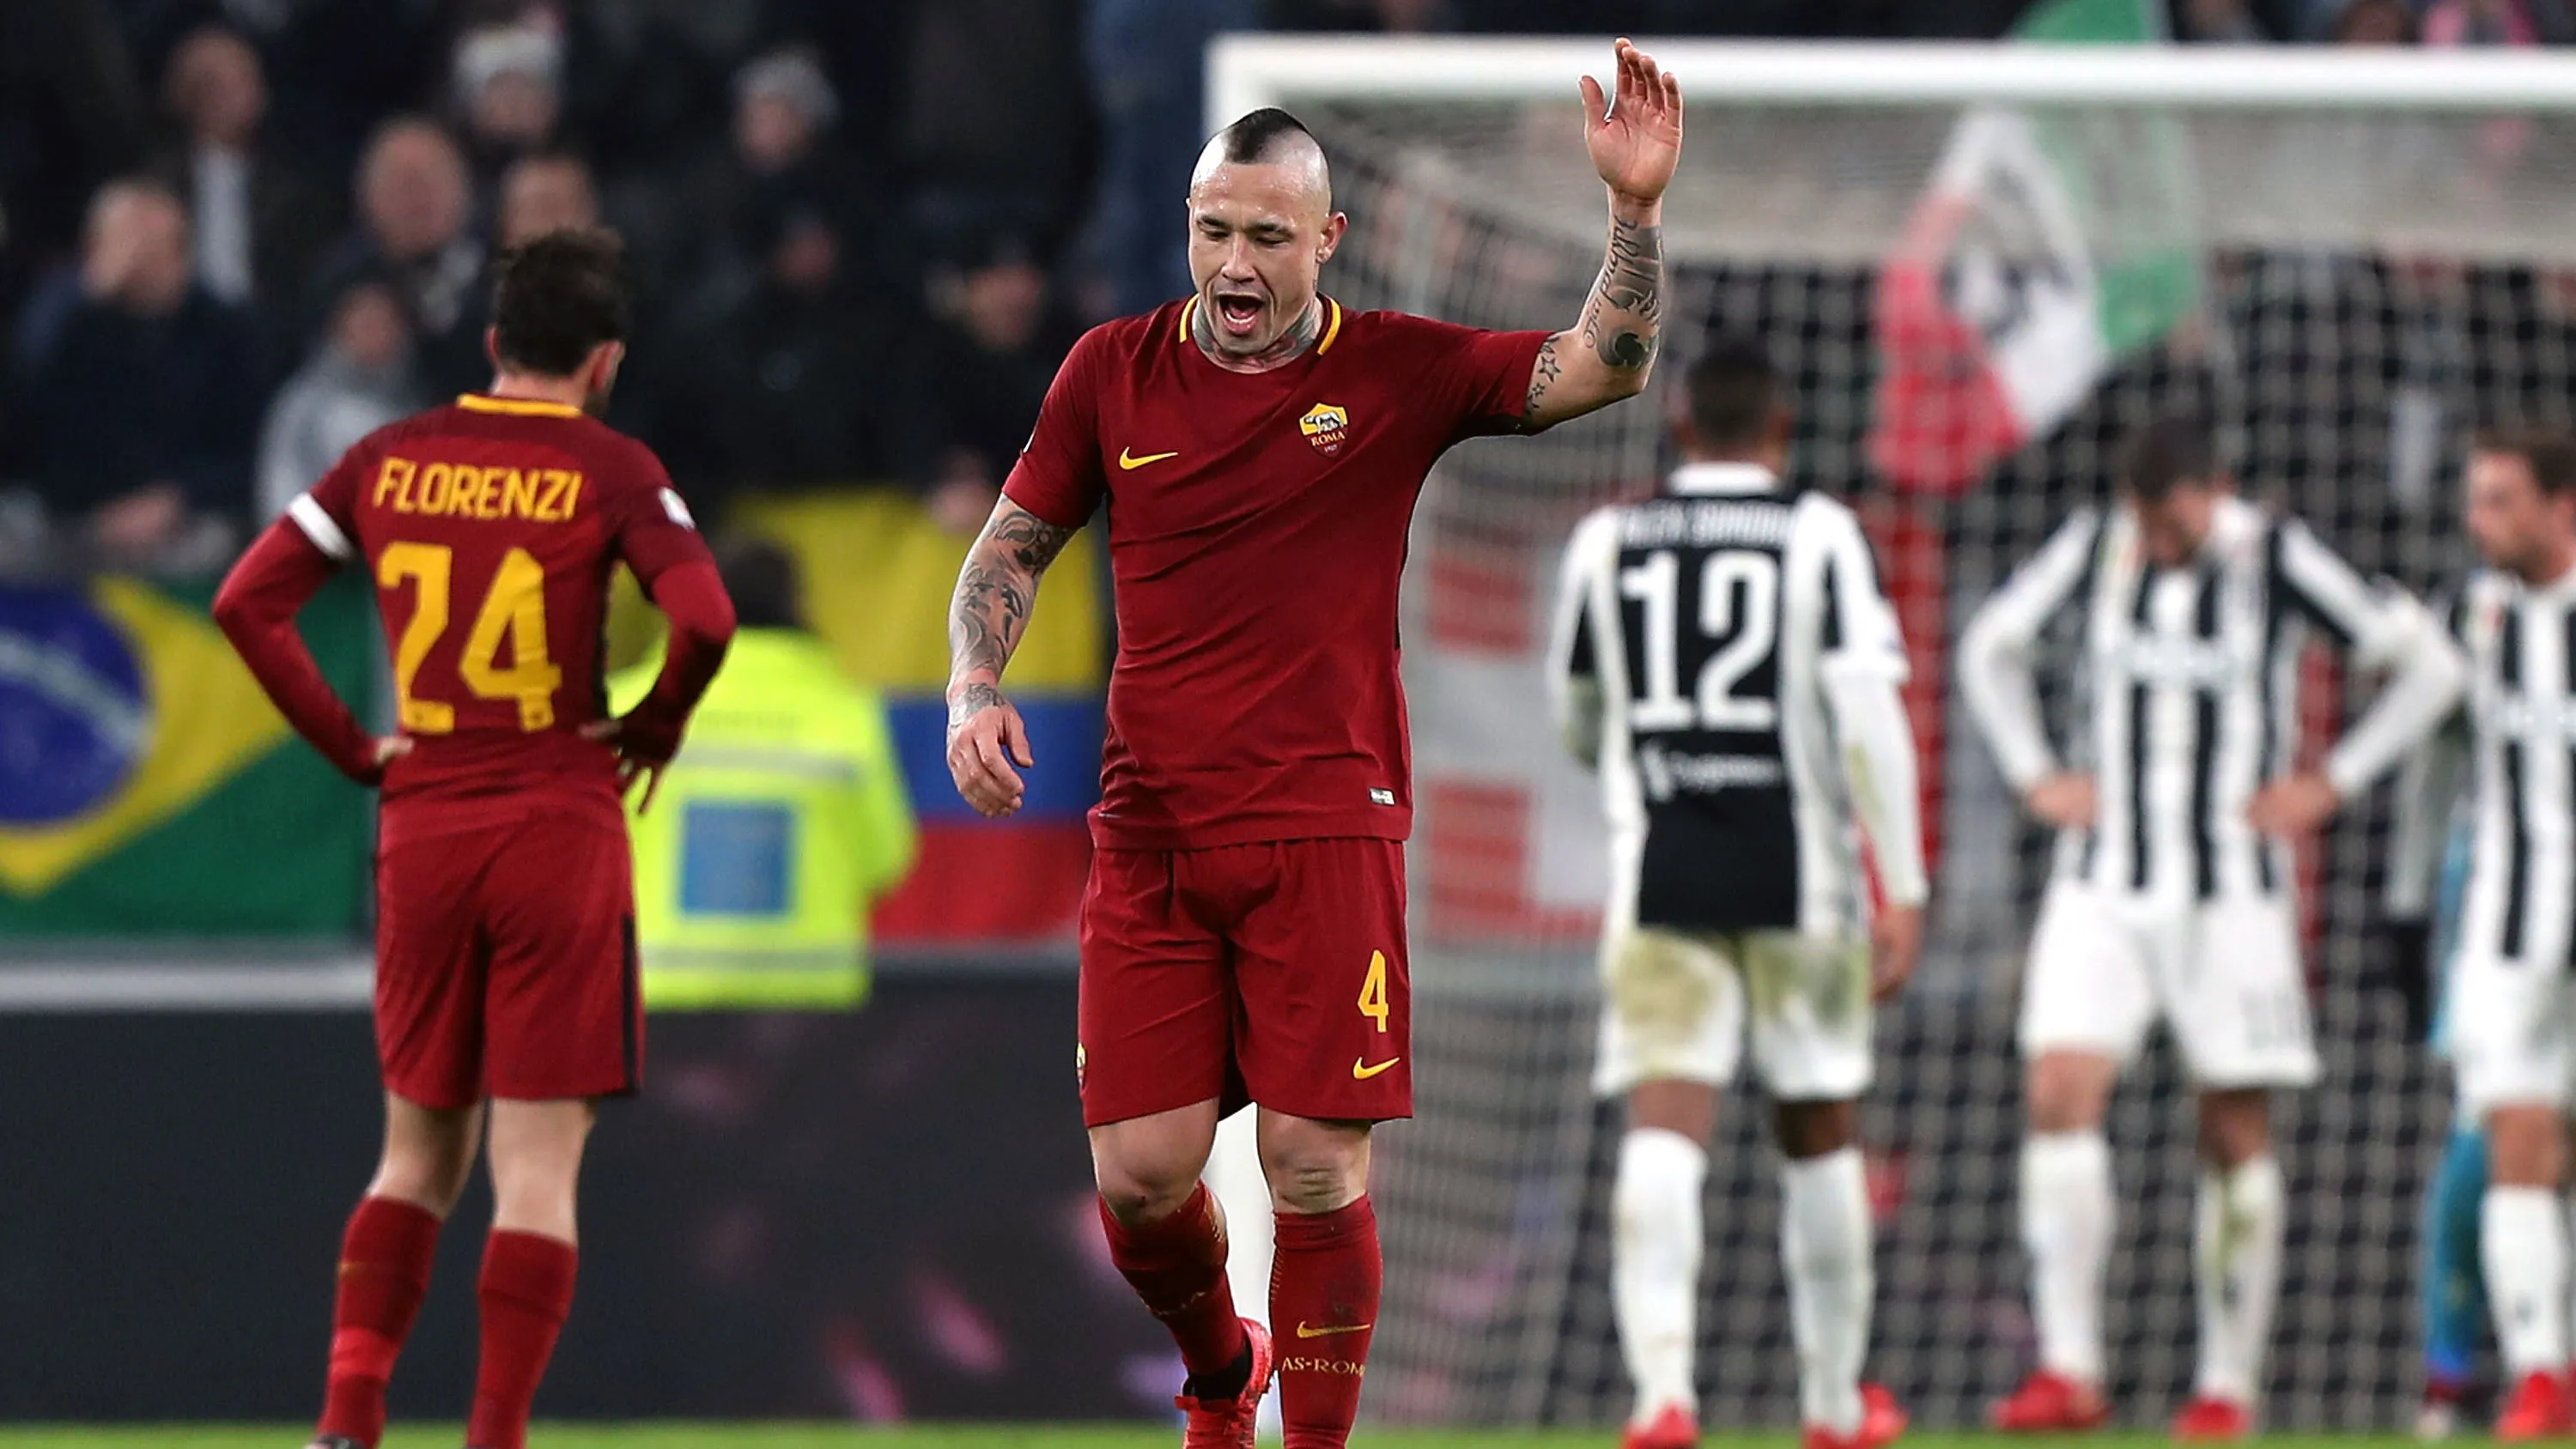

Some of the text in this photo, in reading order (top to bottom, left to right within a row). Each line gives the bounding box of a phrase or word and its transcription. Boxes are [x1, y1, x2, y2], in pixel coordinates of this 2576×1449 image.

[1310, 431, 1346, 446] ROMA
[373, 457, 582, 520] FLORENZI
[378, 542, 562, 734] 24
[1619, 549, 1779, 731] 12
[1358, 949, 1388, 1033] 4
